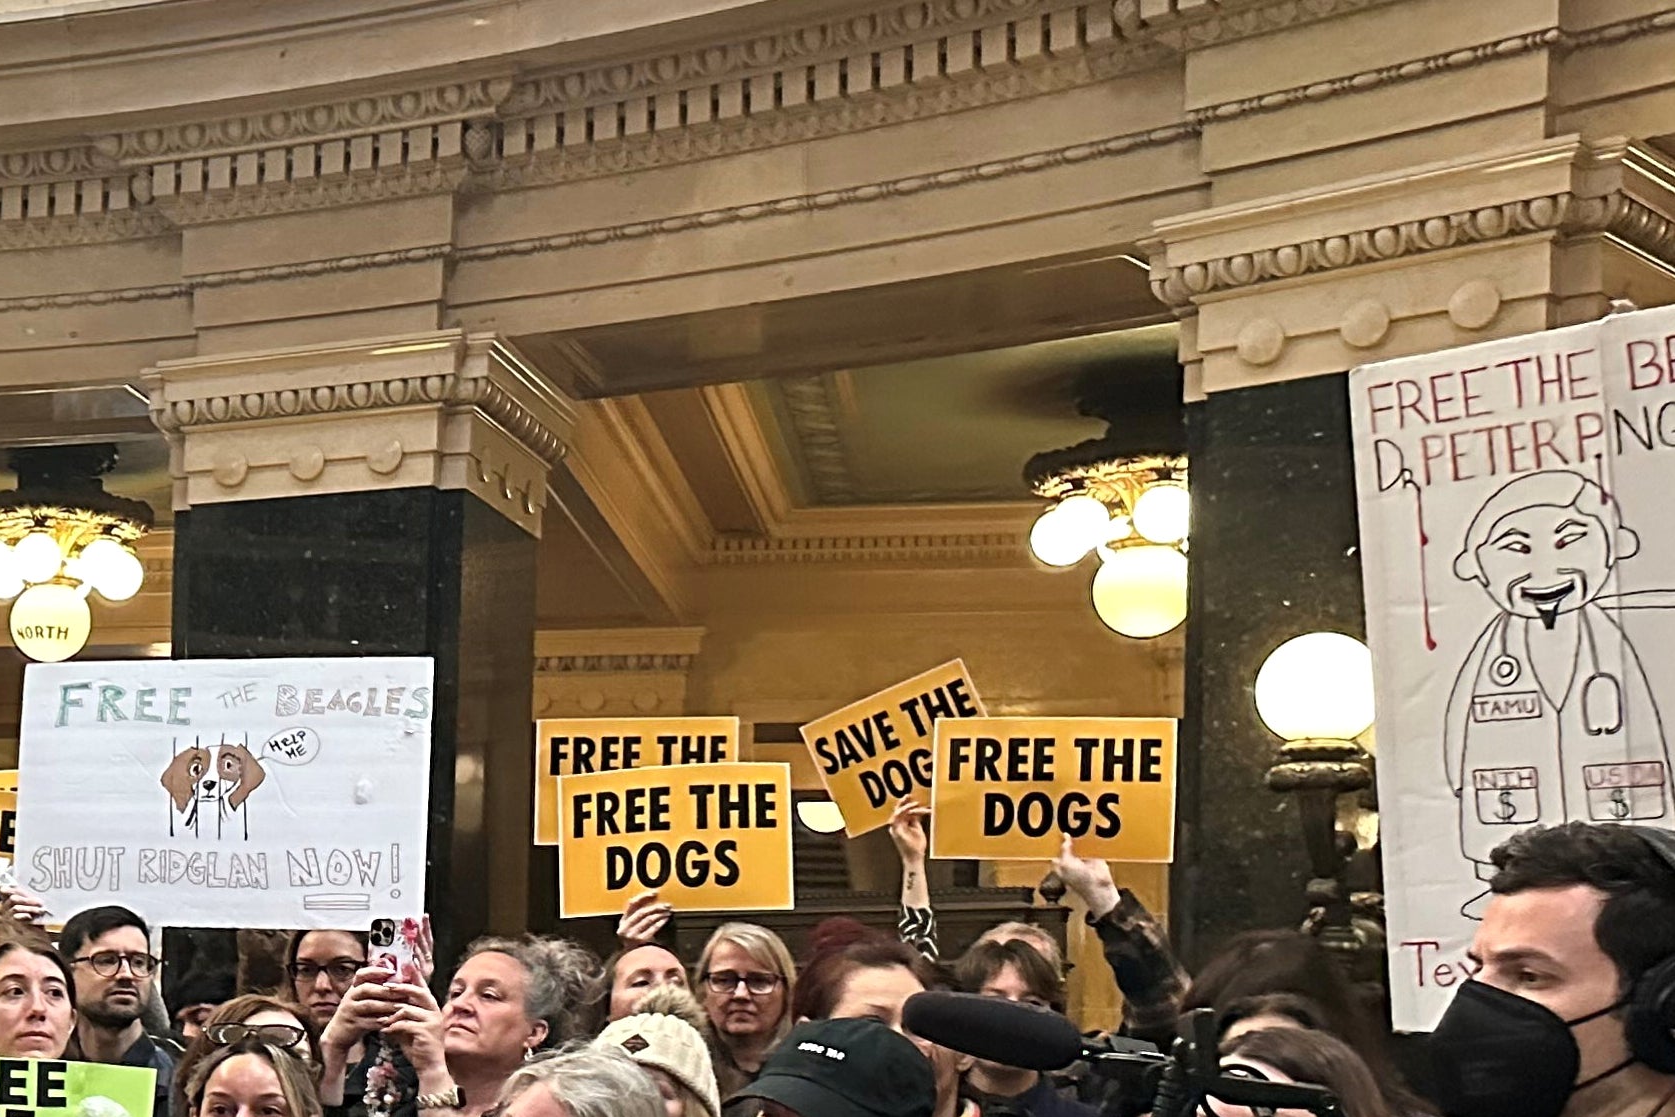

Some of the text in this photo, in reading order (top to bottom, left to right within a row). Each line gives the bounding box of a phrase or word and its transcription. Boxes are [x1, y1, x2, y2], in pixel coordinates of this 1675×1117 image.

[1366, 365, 1494, 433] FREE
[1495, 349, 1599, 409] THE
[1420, 417, 1569, 486] PETER
[54, 681, 430, 728] FREE THE BEAGLES
[815, 677, 979, 776] SAVE THE
[1473, 698, 1536, 717] TAMU
[285, 744, 308, 759] ME
[550, 734, 729, 777] FREE THE
[947, 737, 1162, 783] FREE THE
[572, 782, 778, 840] FREE THE
[982, 791, 1122, 839] DOGS
[28, 842, 403, 899] SHUT RIDGLAN NOW!
[606, 840, 741, 892] DOGS
